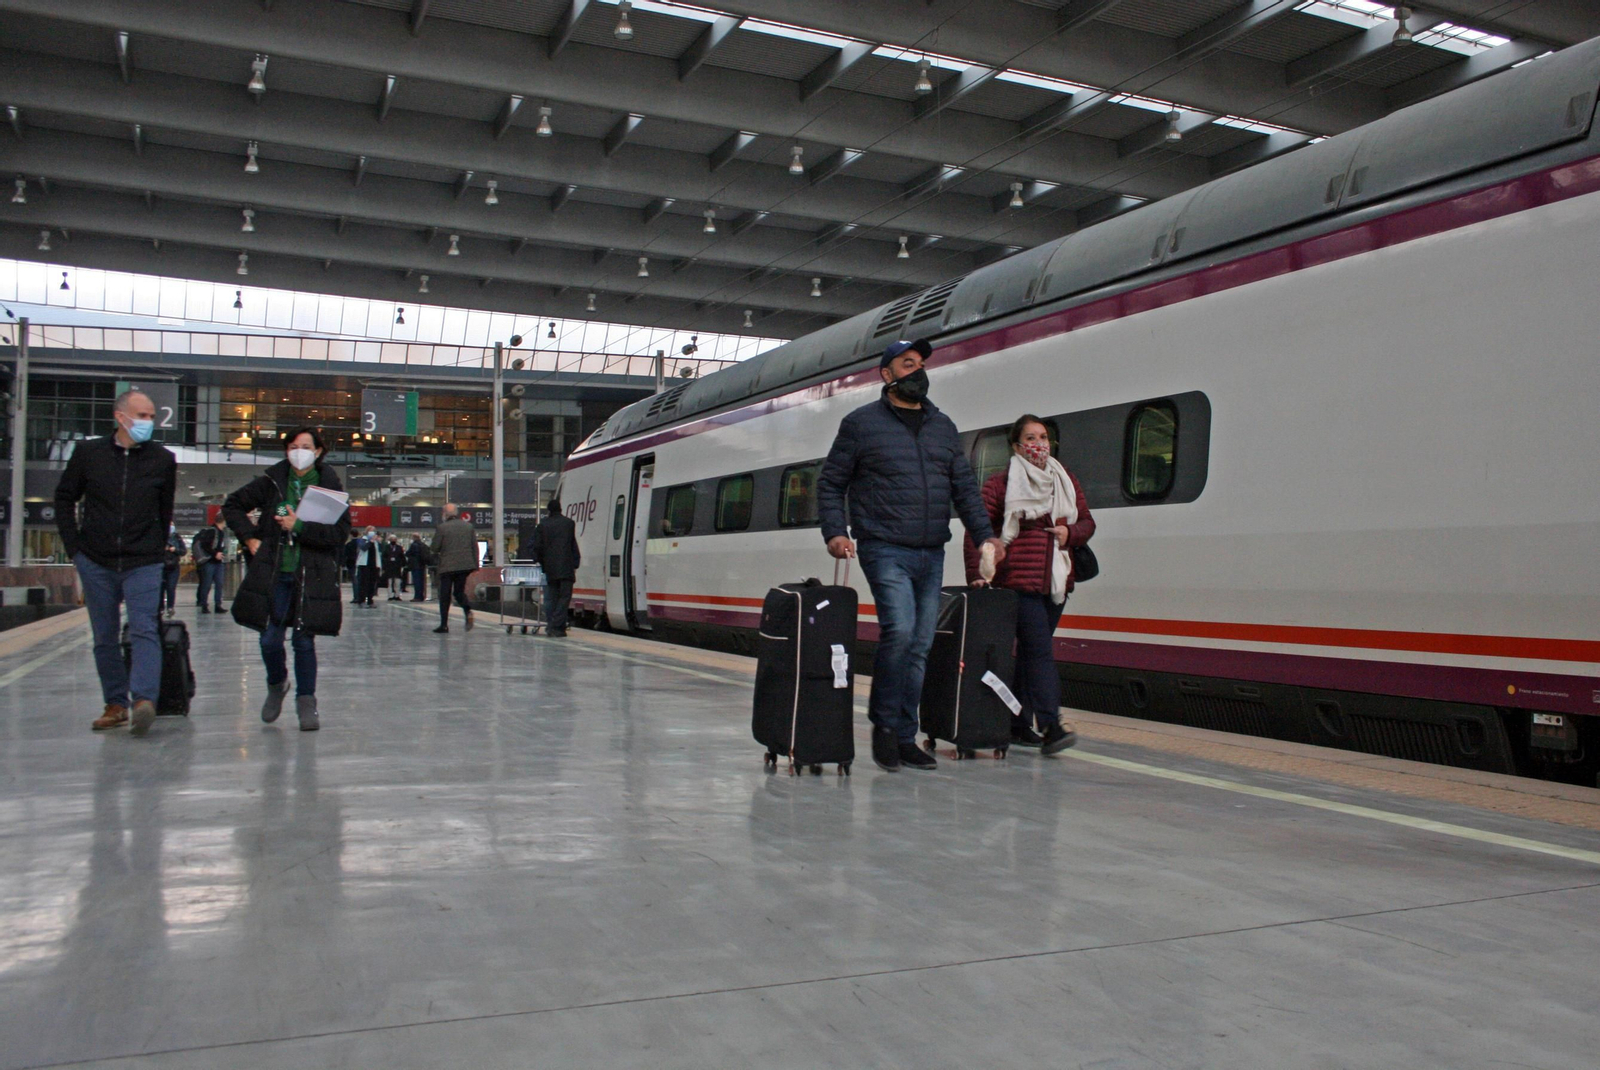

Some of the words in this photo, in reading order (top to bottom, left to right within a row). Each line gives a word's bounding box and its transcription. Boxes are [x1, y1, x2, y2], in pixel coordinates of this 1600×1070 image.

[160, 406, 174, 428] 2
[364, 411, 377, 432] 3
[564, 485, 597, 537] renfe
